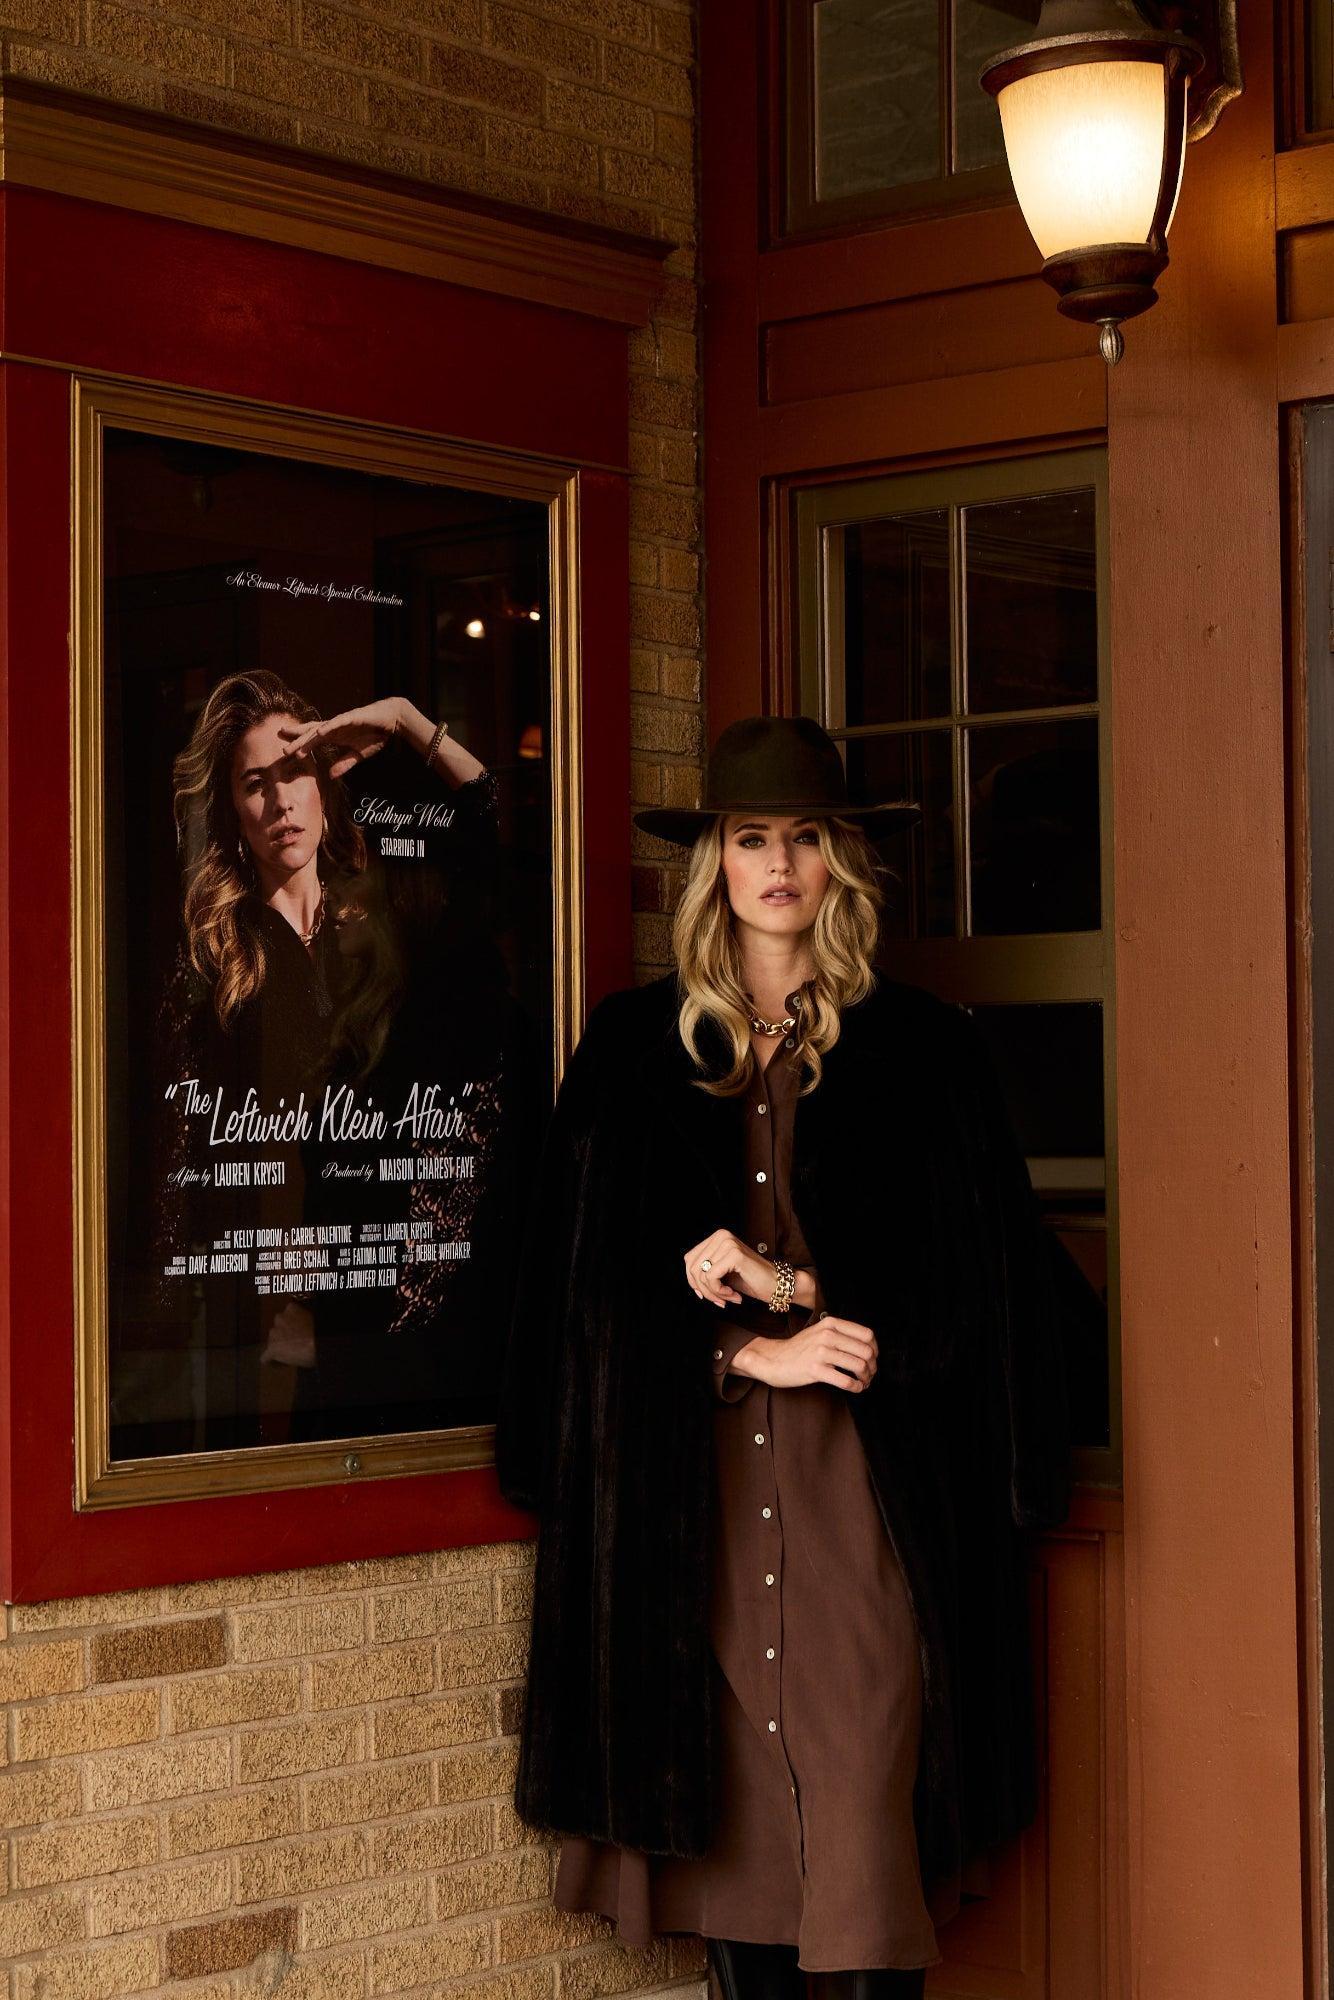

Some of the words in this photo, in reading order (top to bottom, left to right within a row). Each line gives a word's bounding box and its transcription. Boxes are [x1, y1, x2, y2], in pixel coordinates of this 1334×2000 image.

[226, 571, 245, 587] An
[247, 572, 280, 591] Eleanor
[283, 577, 319, 598] Leftwich
[320, 582, 353, 602] Special
[352, 585, 403, 606] Collaboration
[354, 797, 414, 833] Kathryn
[413, 803, 455, 828] Wold
[381, 837, 415, 857] STARRING
[417, 839, 425, 858] IN
[209, 1086, 313, 1146] Leftwich
[318, 1084, 388, 1142] Klein
[200, 1168, 211, 1188] by
[214, 1162, 250, 1187] LAUREN
[253, 1161, 285, 1186] KRYSTI
[321, 1162, 365, 1179] Produced
[364, 1163, 375, 1182] by
[379, 1158, 414, 1182] MAISON
[417, 1156, 454, 1180] CHAREST
[456, 1156, 475, 1179] FAYE
[233, 1229, 254, 1249] KELLY
[256, 1228, 283, 1248] DOROW
[284, 1231, 289, 1246] &
[291, 1227, 315, 1246] CARRIE
[316, 1225, 352, 1244] VALENTINE
[383, 1222, 409, 1241] LAUREN
[410, 1221, 433, 1240] KRYSTI
[283, 1250, 301, 1270] GREG
[303, 1249, 330, 1268] SCHAAL
[352, 1246, 377, 1266] FATIMA
[378, 1245, 397, 1264] OLIVE
[415, 1243, 438, 1262] DEBBIE
[438, 1241, 471, 1260] WHITAKER
[188, 1255, 208, 1275] DAVE
[209, 1253, 249, 1274] ANDERSON
[272, 1274, 303, 1294] ELEANOR
[304, 1272, 338, 1292] LEFTWICH
[339, 1275, 345, 1289] &
[345, 1269, 376, 1289] JENNIFER
[377, 1268, 397, 1287] KLEIN
